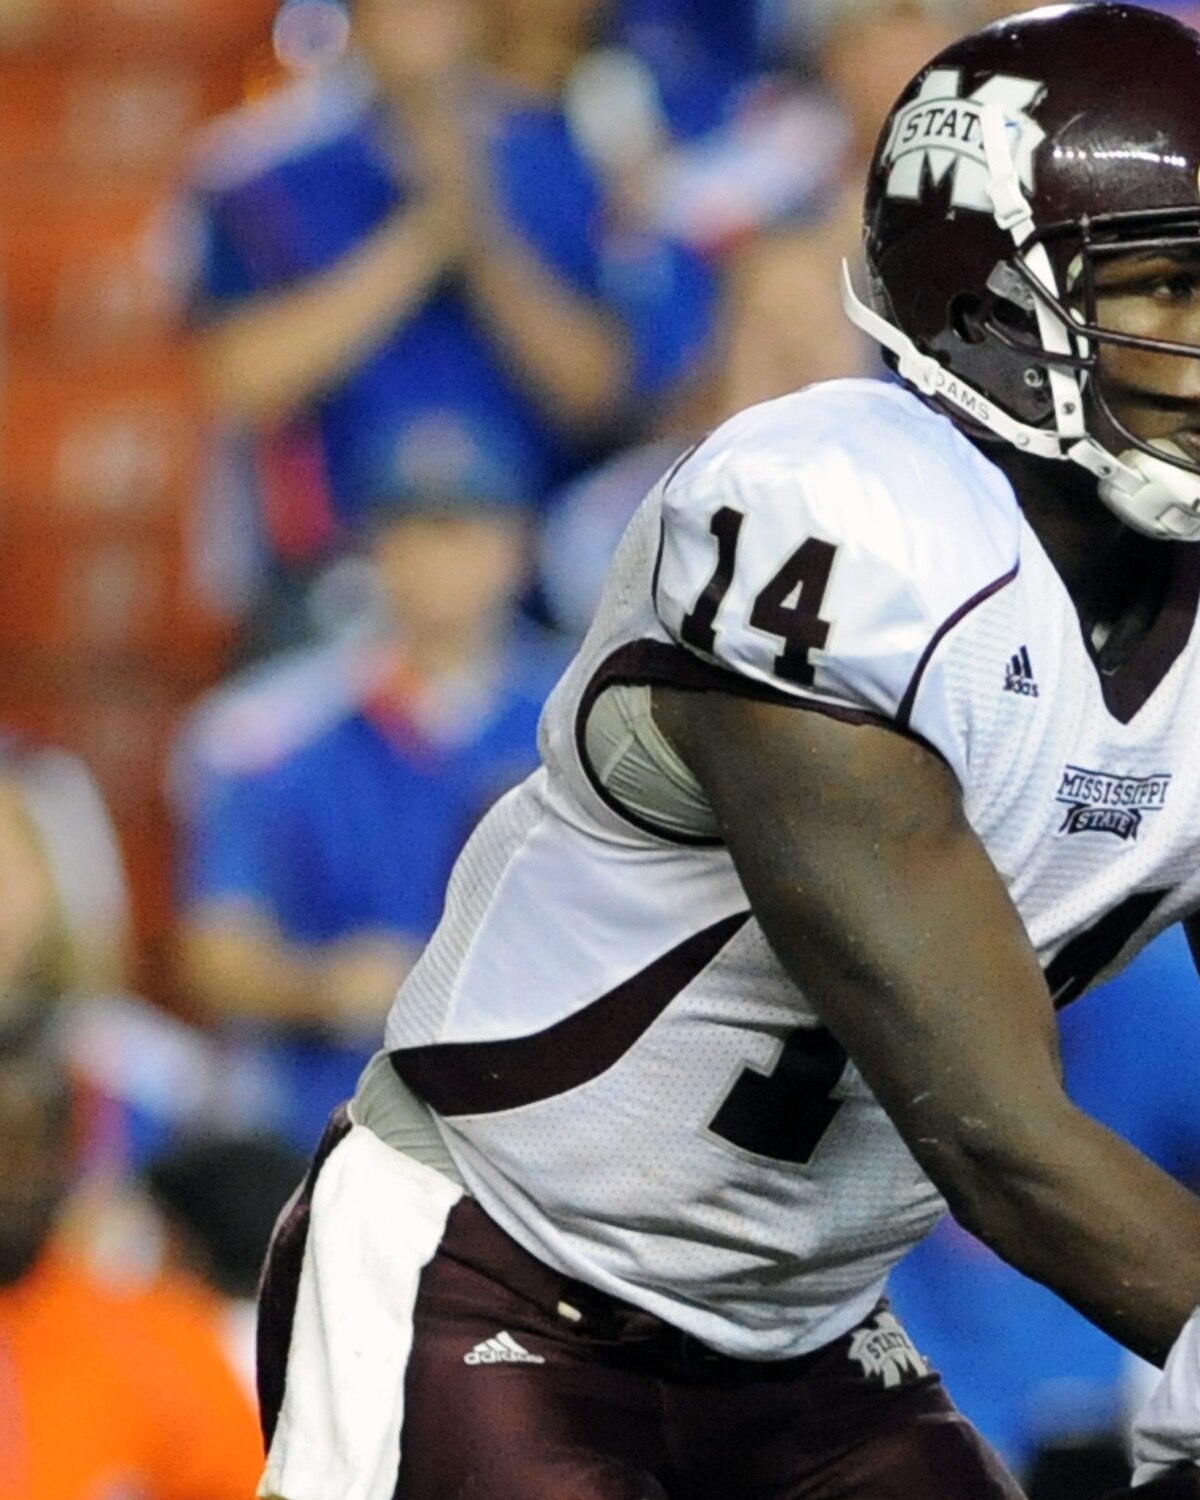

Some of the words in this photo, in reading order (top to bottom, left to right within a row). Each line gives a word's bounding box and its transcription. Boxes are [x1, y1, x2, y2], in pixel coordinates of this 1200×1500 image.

[902, 107, 986, 151] STAT
[935, 371, 990, 420] DAMS
[680, 505, 839, 687] 14
[1057, 771, 1169, 806] MISSISSIPPI
[1074, 811, 1130, 834] STATE
